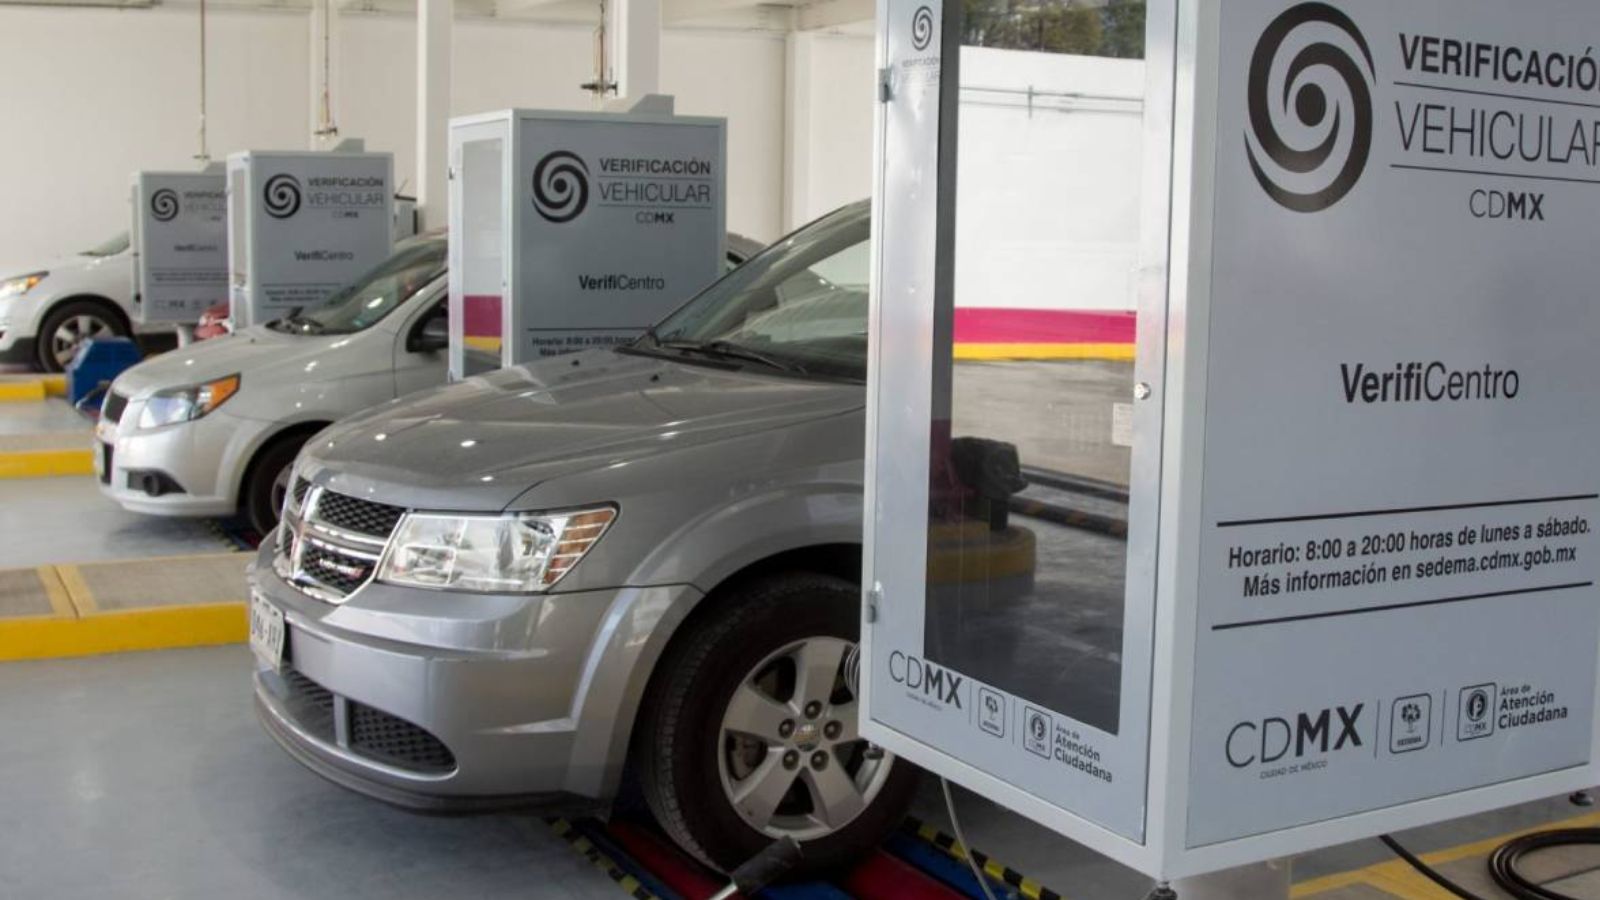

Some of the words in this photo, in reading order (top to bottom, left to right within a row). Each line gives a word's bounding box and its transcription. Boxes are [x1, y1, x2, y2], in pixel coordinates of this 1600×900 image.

[1399, 32, 1600, 91] VERIFICACIÓ
[599, 157, 711, 175] VERIFICACIÓN
[598, 182, 711, 202] VEHICULAR
[1469, 189, 1545, 220] CDMX
[635, 211, 675, 223] CDMX
[578, 274, 665, 290] VerifiCentro
[1340, 361, 1519, 403] VerifiCentro
[1228, 542, 1300, 569] Horario:
[1305, 538, 1342, 561] 8:00
[1346, 541, 1356, 557] a
[1361, 532, 1405, 556] 20:00
[1409, 528, 1453, 551] horas
[1458, 525, 1476, 546] de
[1480, 524, 1520, 544] lunes
[1524, 523, 1532, 540] a
[1536, 515, 1590, 539] sábado.
[1243, 572, 1281, 597] Más
[1286, 562, 1387, 593] información
[1392, 563, 1411, 582] en
[1416, 546, 1577, 579] sedema.cdmx.gob.mx
[889, 650, 962, 710] CDMX
[1500, 691, 1554, 711] Atención
[1498, 705, 1568, 730] Ciudadana
[1055, 733, 1101, 762] Atención
[1225, 702, 1364, 769] CDMX
[1054, 747, 1113, 783] Ciudadana
